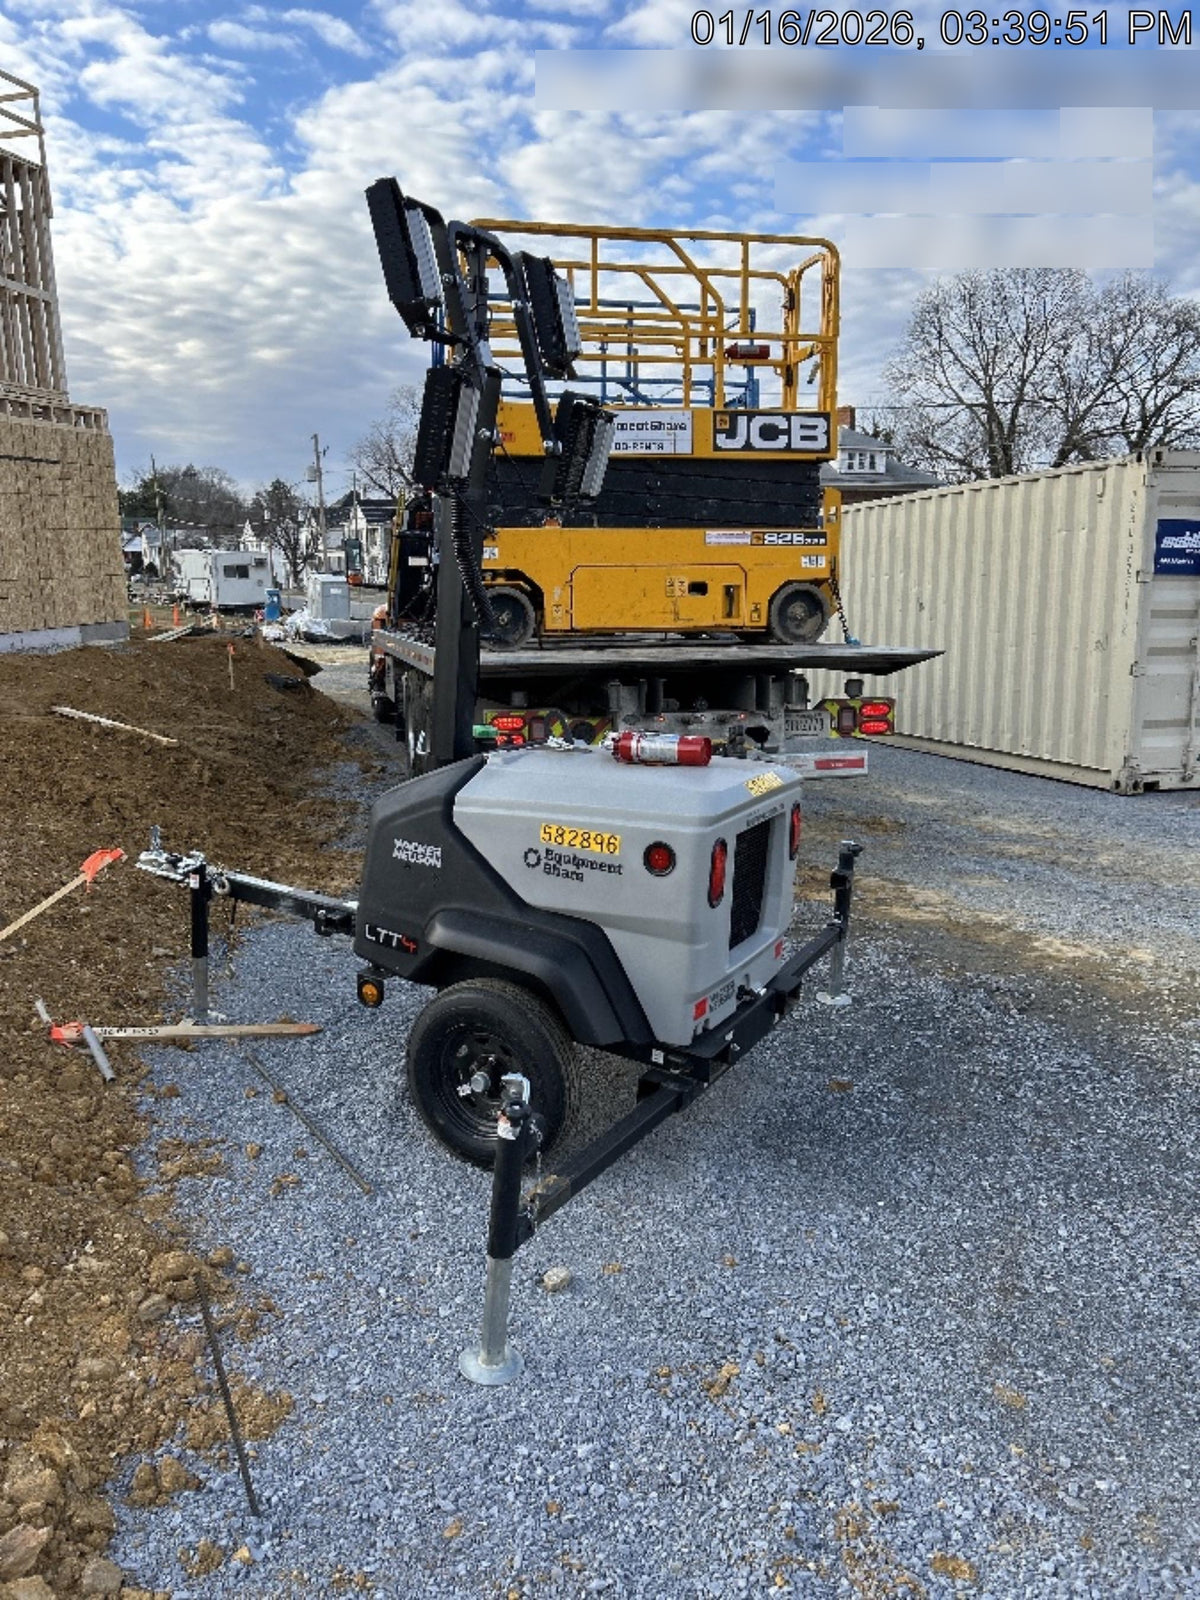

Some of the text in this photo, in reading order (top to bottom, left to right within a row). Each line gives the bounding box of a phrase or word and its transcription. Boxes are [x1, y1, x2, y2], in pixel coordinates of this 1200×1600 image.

[715, 415, 828, 450] JCB
[393, 838, 442, 857] WACKER
[541, 824, 618, 854] 582896
[392, 847, 442, 869] NEUSON
[543, 861, 584, 882] Share
[544, 847, 624, 876] Equipment
[365, 923, 417, 953] LTT4
